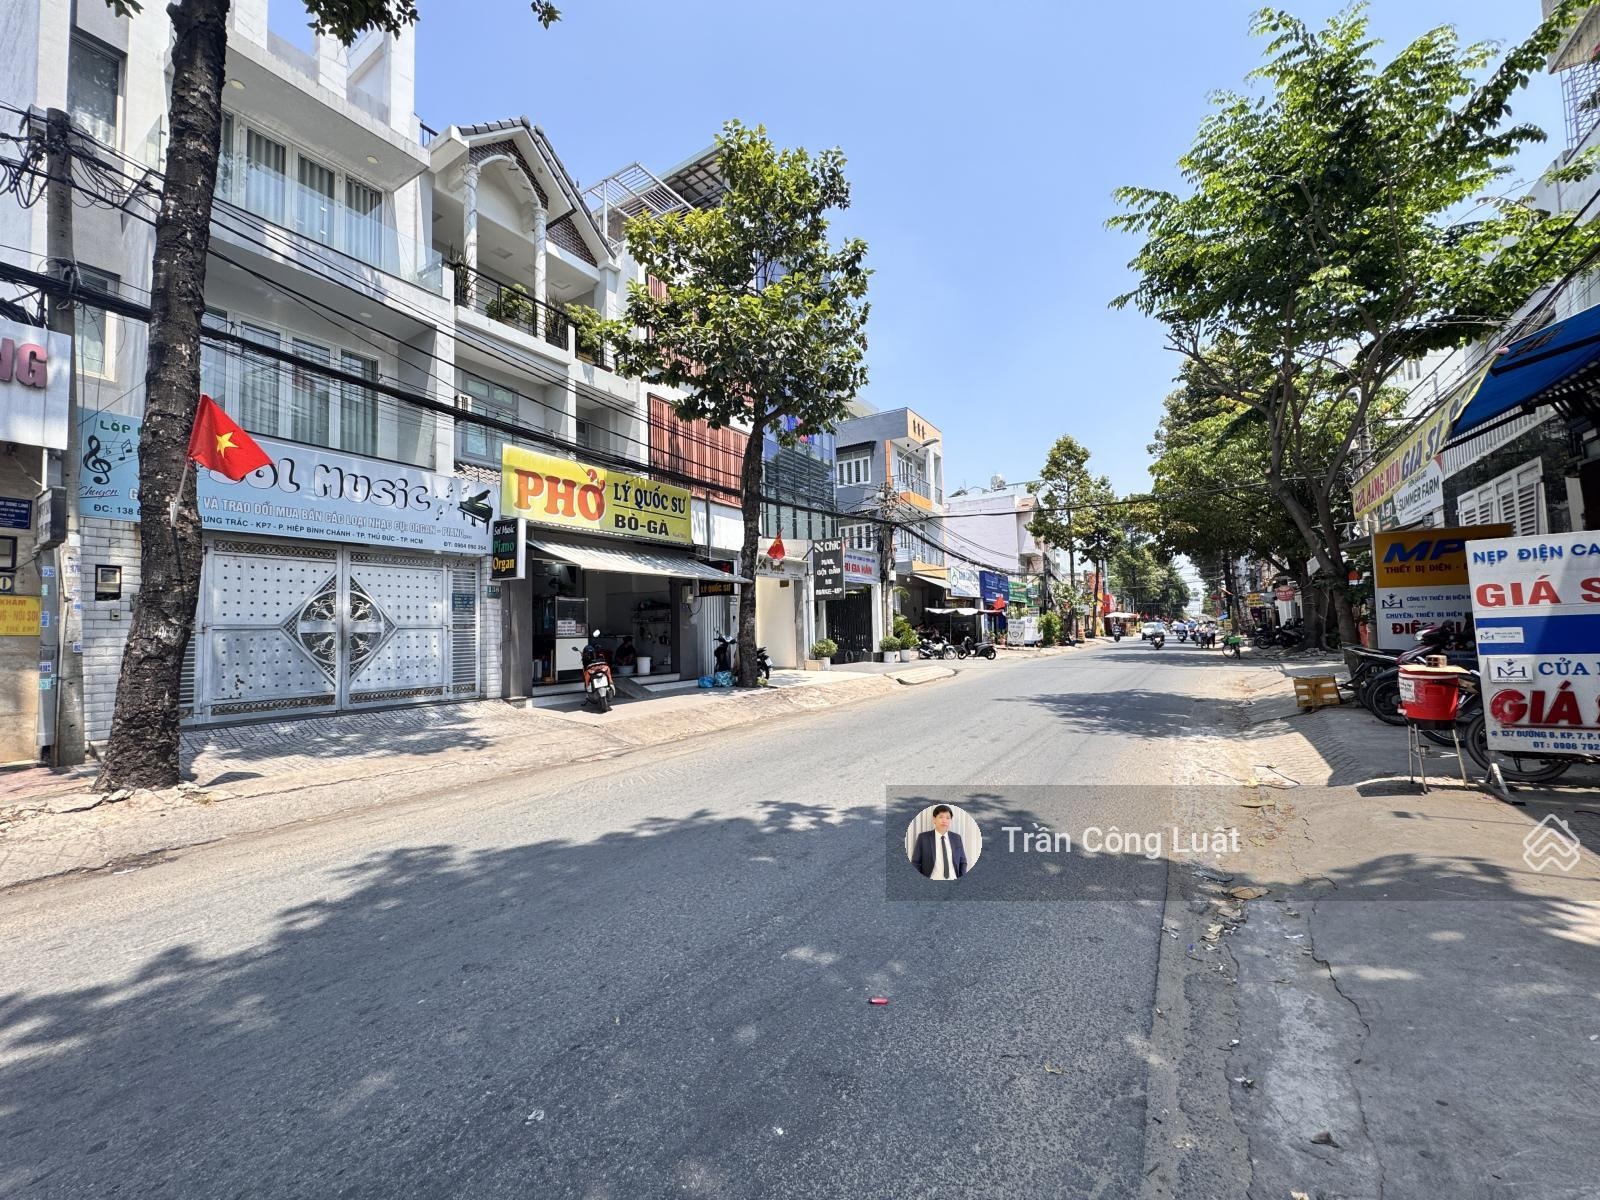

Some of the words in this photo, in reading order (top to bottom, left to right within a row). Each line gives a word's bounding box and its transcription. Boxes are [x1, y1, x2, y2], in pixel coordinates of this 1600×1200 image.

[514, 468, 606, 521] PHỞ
[613, 480, 631, 502] LÝ
[634, 485, 669, 510] QUỐC
[671, 496, 687, 514] SƯ
[1422, 475, 1440, 499] FARM
[116, 507, 134, 516] 138
[203, 496, 219, 510] VÀ
[222, 499, 251, 513] TRAO
[276, 506, 299, 519] MUA
[301, 507, 323, 522] BÁN
[325, 511, 344, 525] CÁC
[345, 514, 366, 529] LOẠI
[367, 517, 393, 531] NHẠC
[409, 522, 436, 535] ORGAN
[255, 520, 272, 530] KP7
[278, 524, 285, 532] P.
[326, 528, 351, 538] CHÁNH
[410, 537, 424, 545] HCM
[614, 513, 670, 536] BÒ-GÀ
[494, 540, 515, 554] Piano
[1472, 550, 1509, 567] NẸP
[1517, 543, 1563, 563] ĐIỆN
[493, 556, 515, 572] Organ
[1476, 574, 1563, 608] GIÁ
[1538, 657, 1590, 676] CỬA
[1490, 680, 1584, 724] GIÁ
[1516, 729, 1548, 739] ĐƯỜNG
